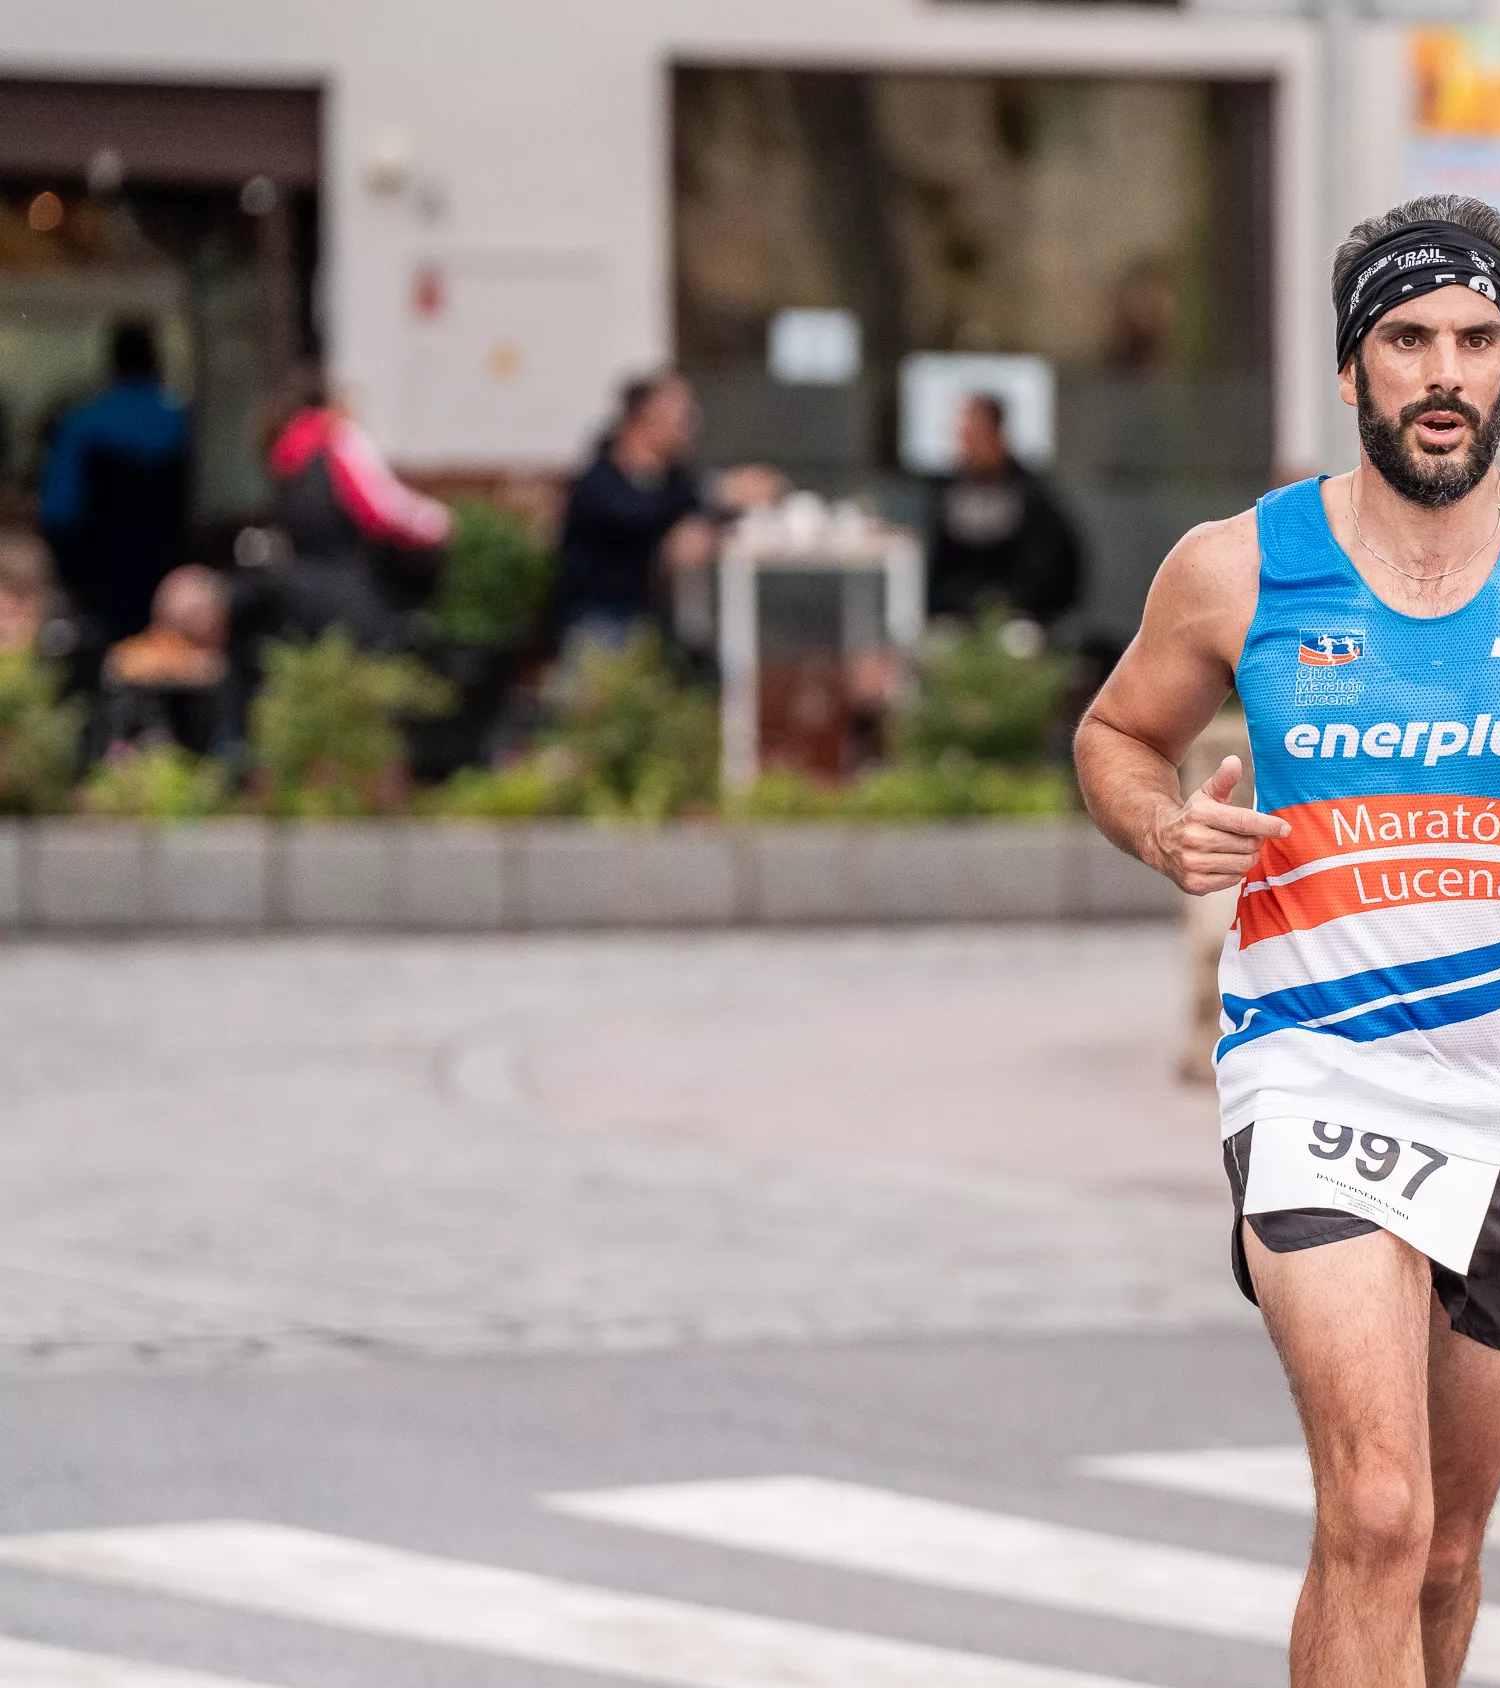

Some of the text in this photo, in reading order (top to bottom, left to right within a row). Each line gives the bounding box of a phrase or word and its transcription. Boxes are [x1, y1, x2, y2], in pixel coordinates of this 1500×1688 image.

[1394, 248, 1446, 266] TRAIL
[1296, 667, 1336, 681] Club
[1295, 679, 1365, 694] Maratón
[1295, 694, 1359, 706] Lucena
[1308, 1120, 1449, 1200] 997
[1316, 1172, 1347, 1188] DAVID
